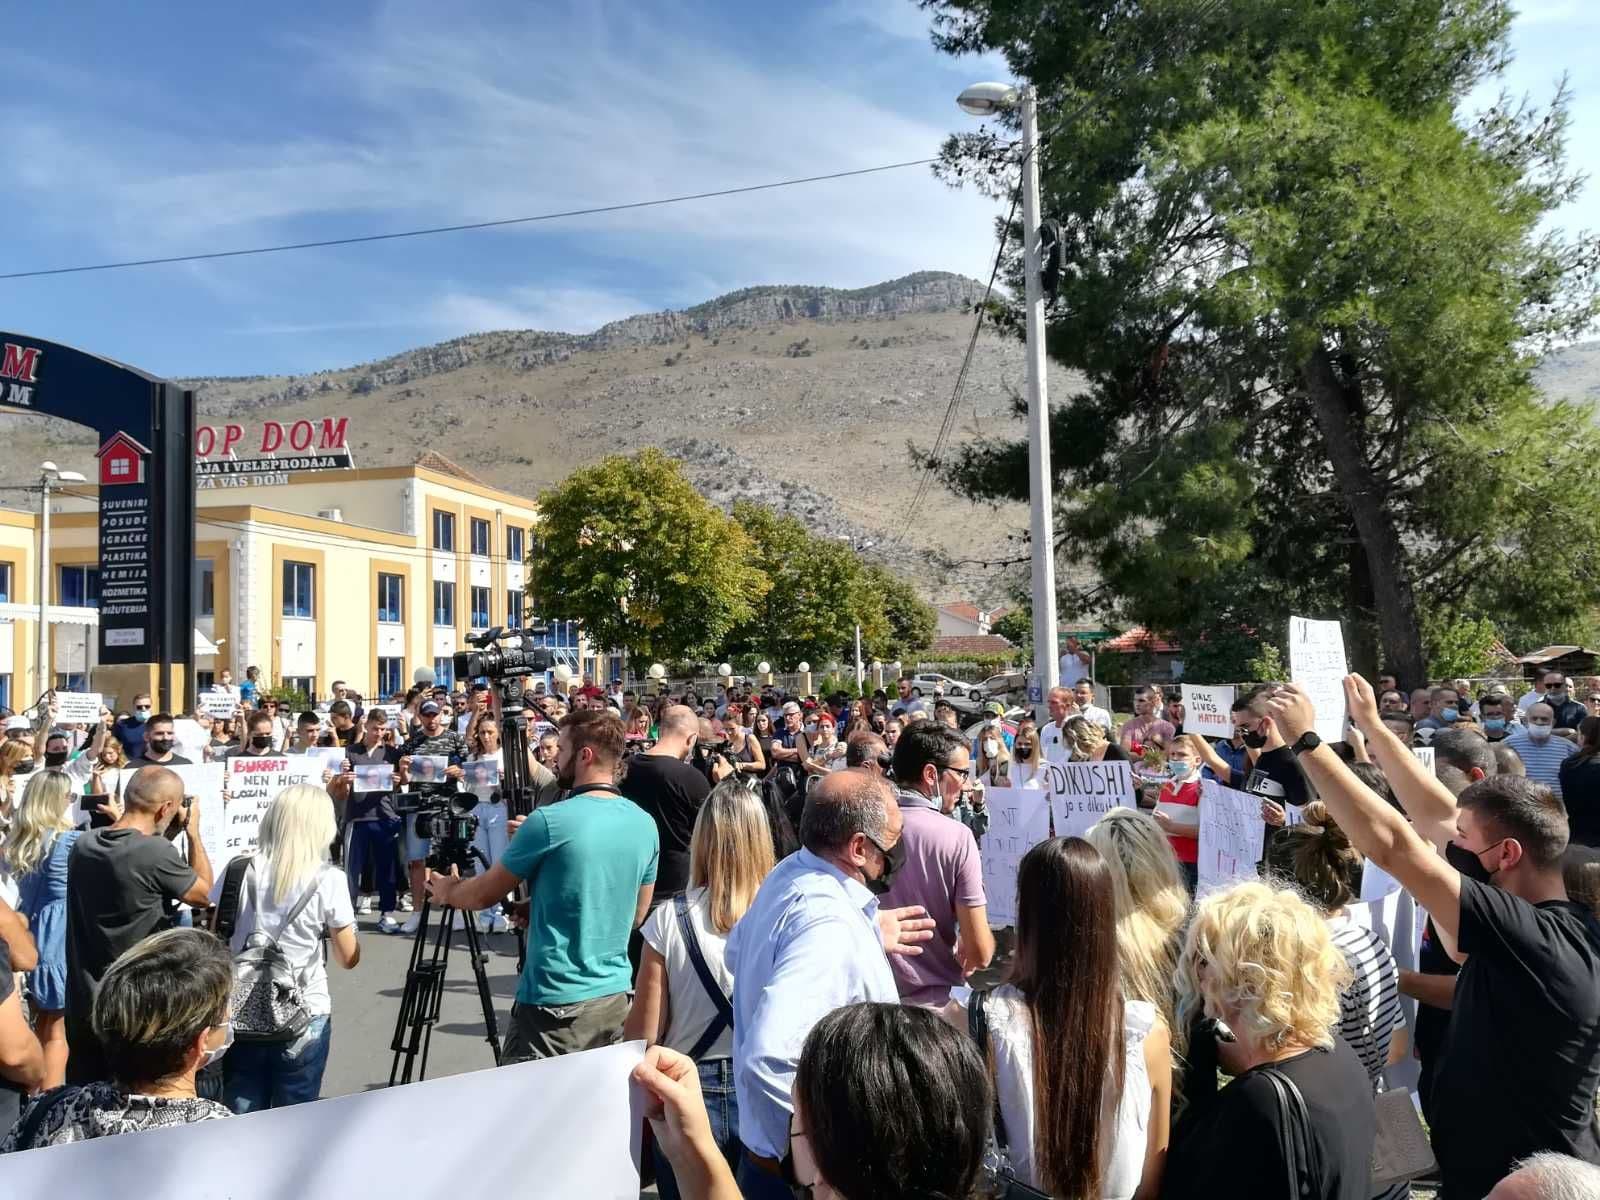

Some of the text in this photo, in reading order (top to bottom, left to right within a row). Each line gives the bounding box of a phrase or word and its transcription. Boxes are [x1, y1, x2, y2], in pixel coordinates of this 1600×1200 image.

[260, 417, 348, 452] DOM
[223, 462, 230, 473] I
[232, 457, 336, 472] VELEPRODAJA
[253, 474, 288, 486] DOM
[102, 498, 148, 510] SUVENIRI
[102, 551, 148, 562] PLASTIKA
[102, 569, 148, 579] HEMIJA
[102, 587, 148, 597] KOZMETIKA
[1192, 702, 1217, 713] LIVES
[1199, 713, 1227, 724] MATTER
[1050, 762, 1126, 795] DIKUSHI
[232, 814, 259, 824] PIKA
